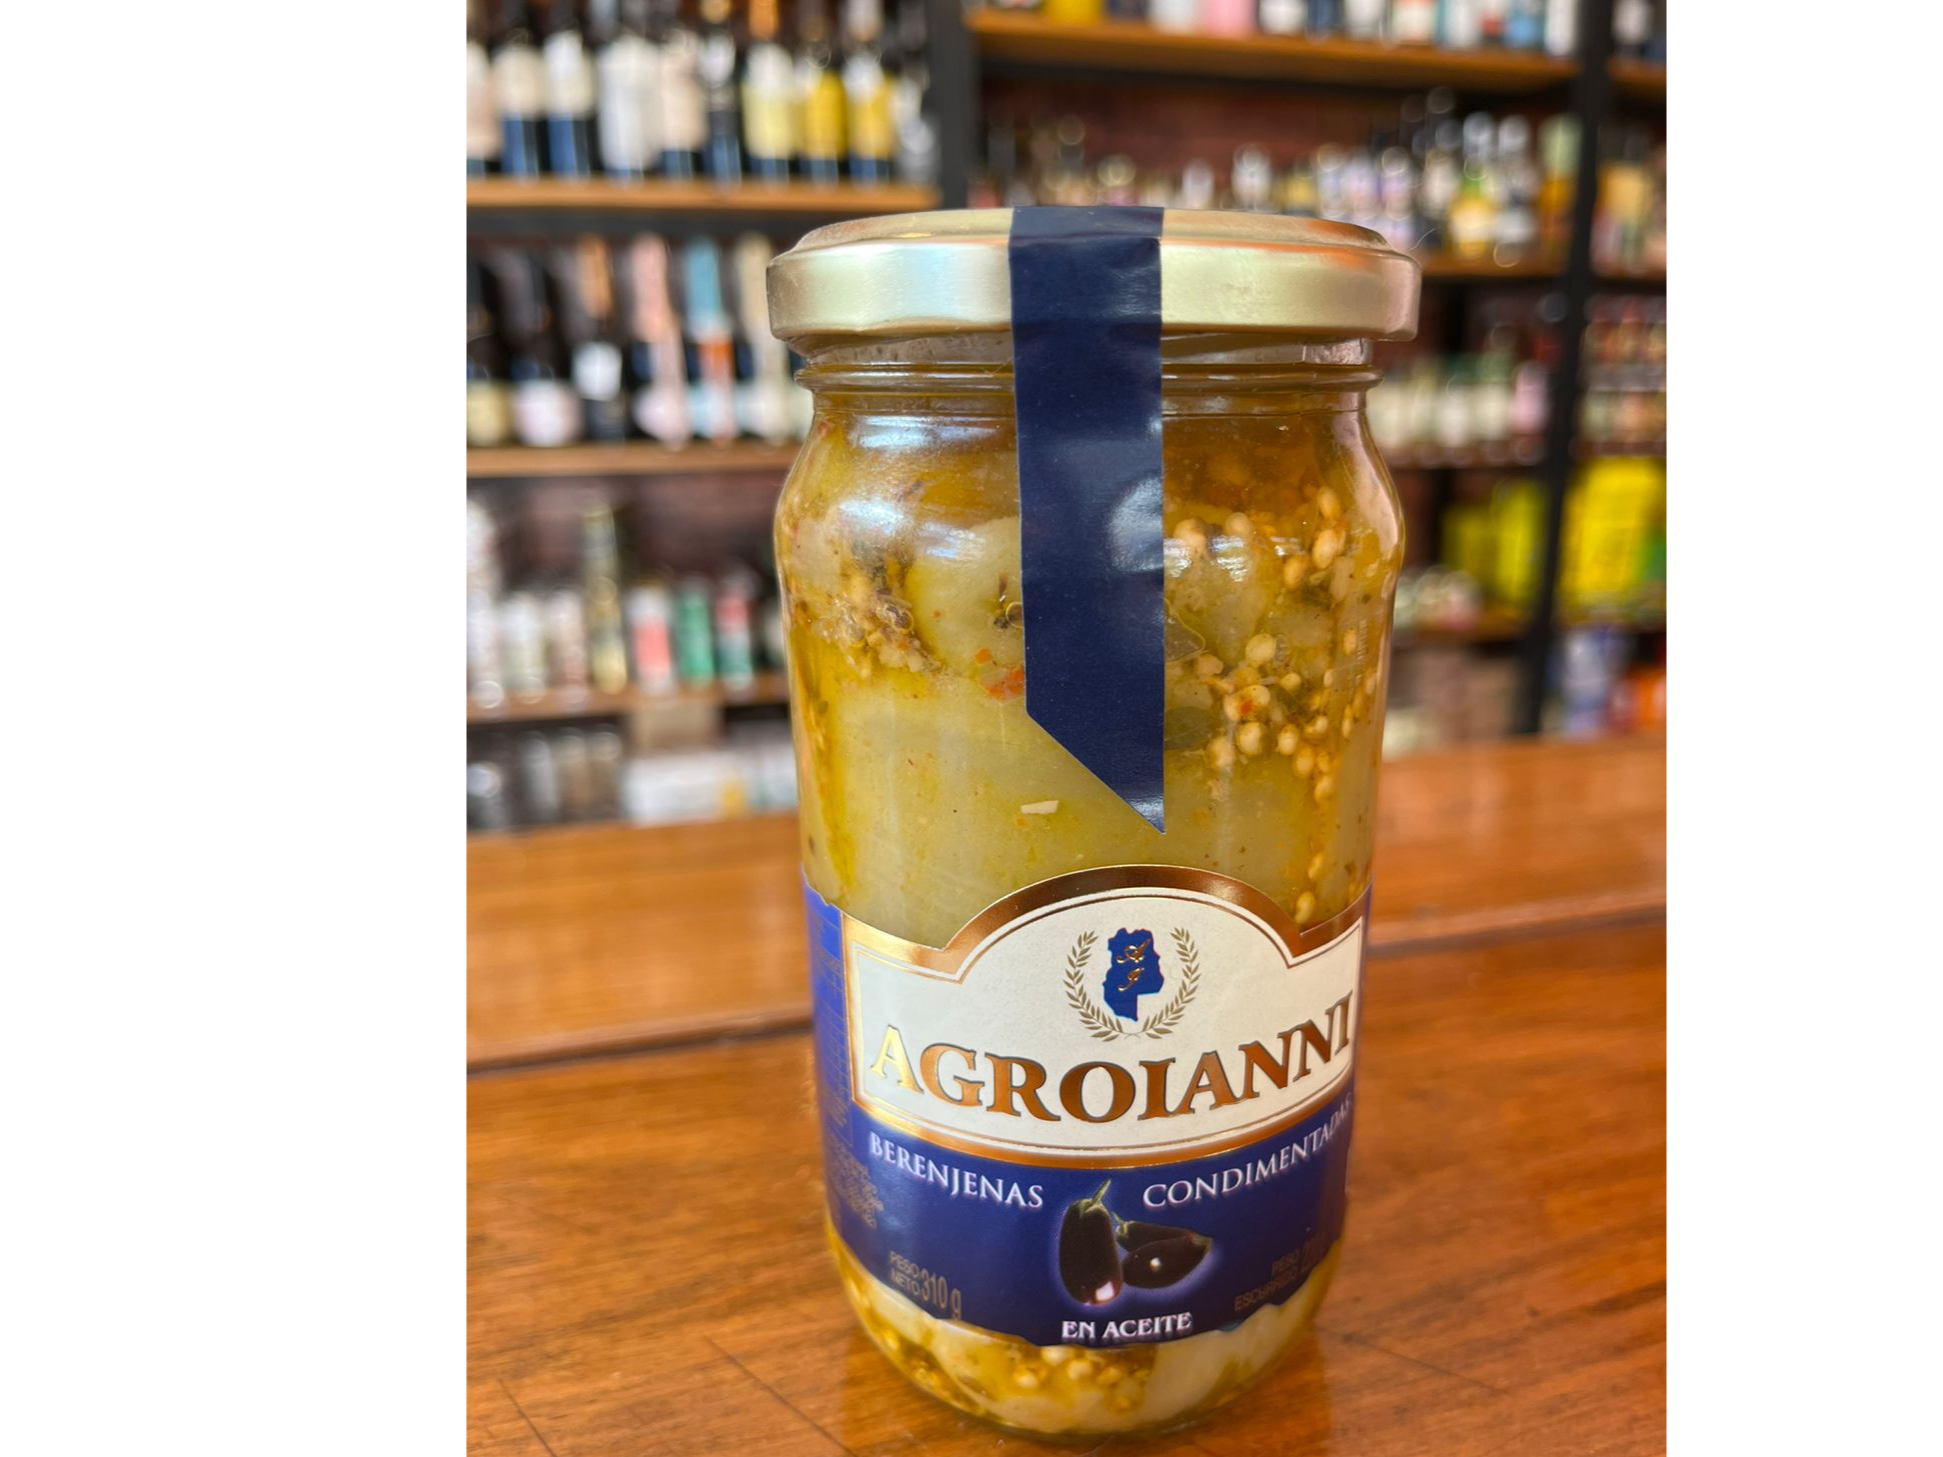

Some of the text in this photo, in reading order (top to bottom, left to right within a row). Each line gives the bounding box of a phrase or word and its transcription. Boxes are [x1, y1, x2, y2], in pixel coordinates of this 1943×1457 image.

[870, 990, 1354, 1124] AGROIANNI
[868, 1132, 1045, 1210] BERENJENAS
[889, 1249, 920, 1279] PESO
[889, 1267, 920, 1296] NETO
[921, 1267, 948, 1309] 310
[1061, 1311, 1193, 1339] EN ACEITE
